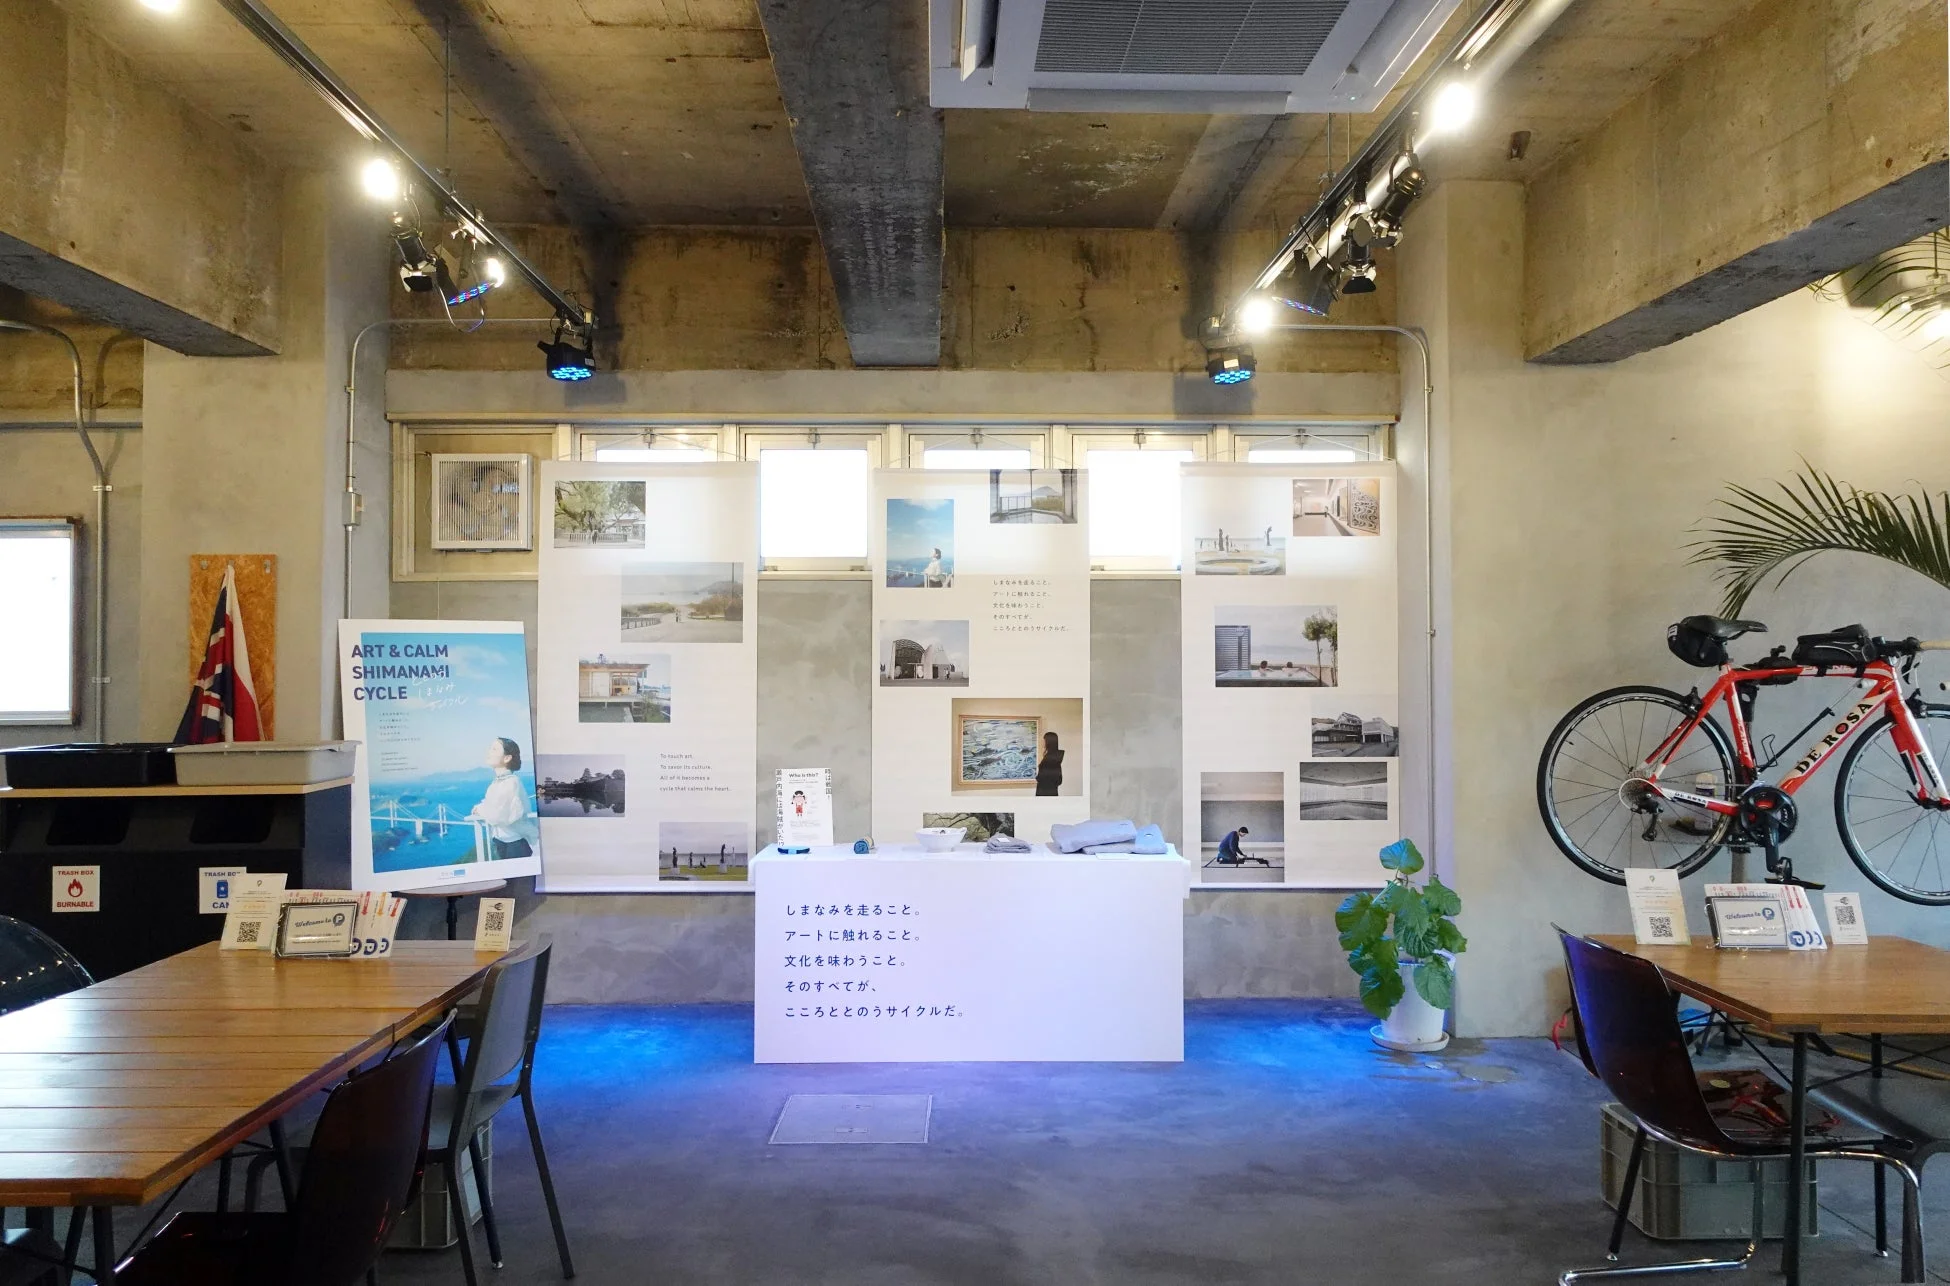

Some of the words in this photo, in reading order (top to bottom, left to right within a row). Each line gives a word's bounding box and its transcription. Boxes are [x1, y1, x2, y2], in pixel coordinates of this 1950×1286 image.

[352, 644, 384, 658] ART
[389, 644, 400, 658] &
[404, 644, 448, 658] CALM
[352, 664, 450, 680] SHIMANAMI
[354, 686, 408, 700] CYCLE
[1795, 749, 1822, 774] DE
[1822, 703, 1874, 747] ROSA
[786, 904, 920, 916] しまなみを走ること。
[785, 929, 920, 942] アートに触れること。
[784, 955, 905, 967] 文化を味わうこと。
[785, 980, 877, 992] そのすべてが、
[785, 1005, 963, 1017] こころととのうサイクルだ。
